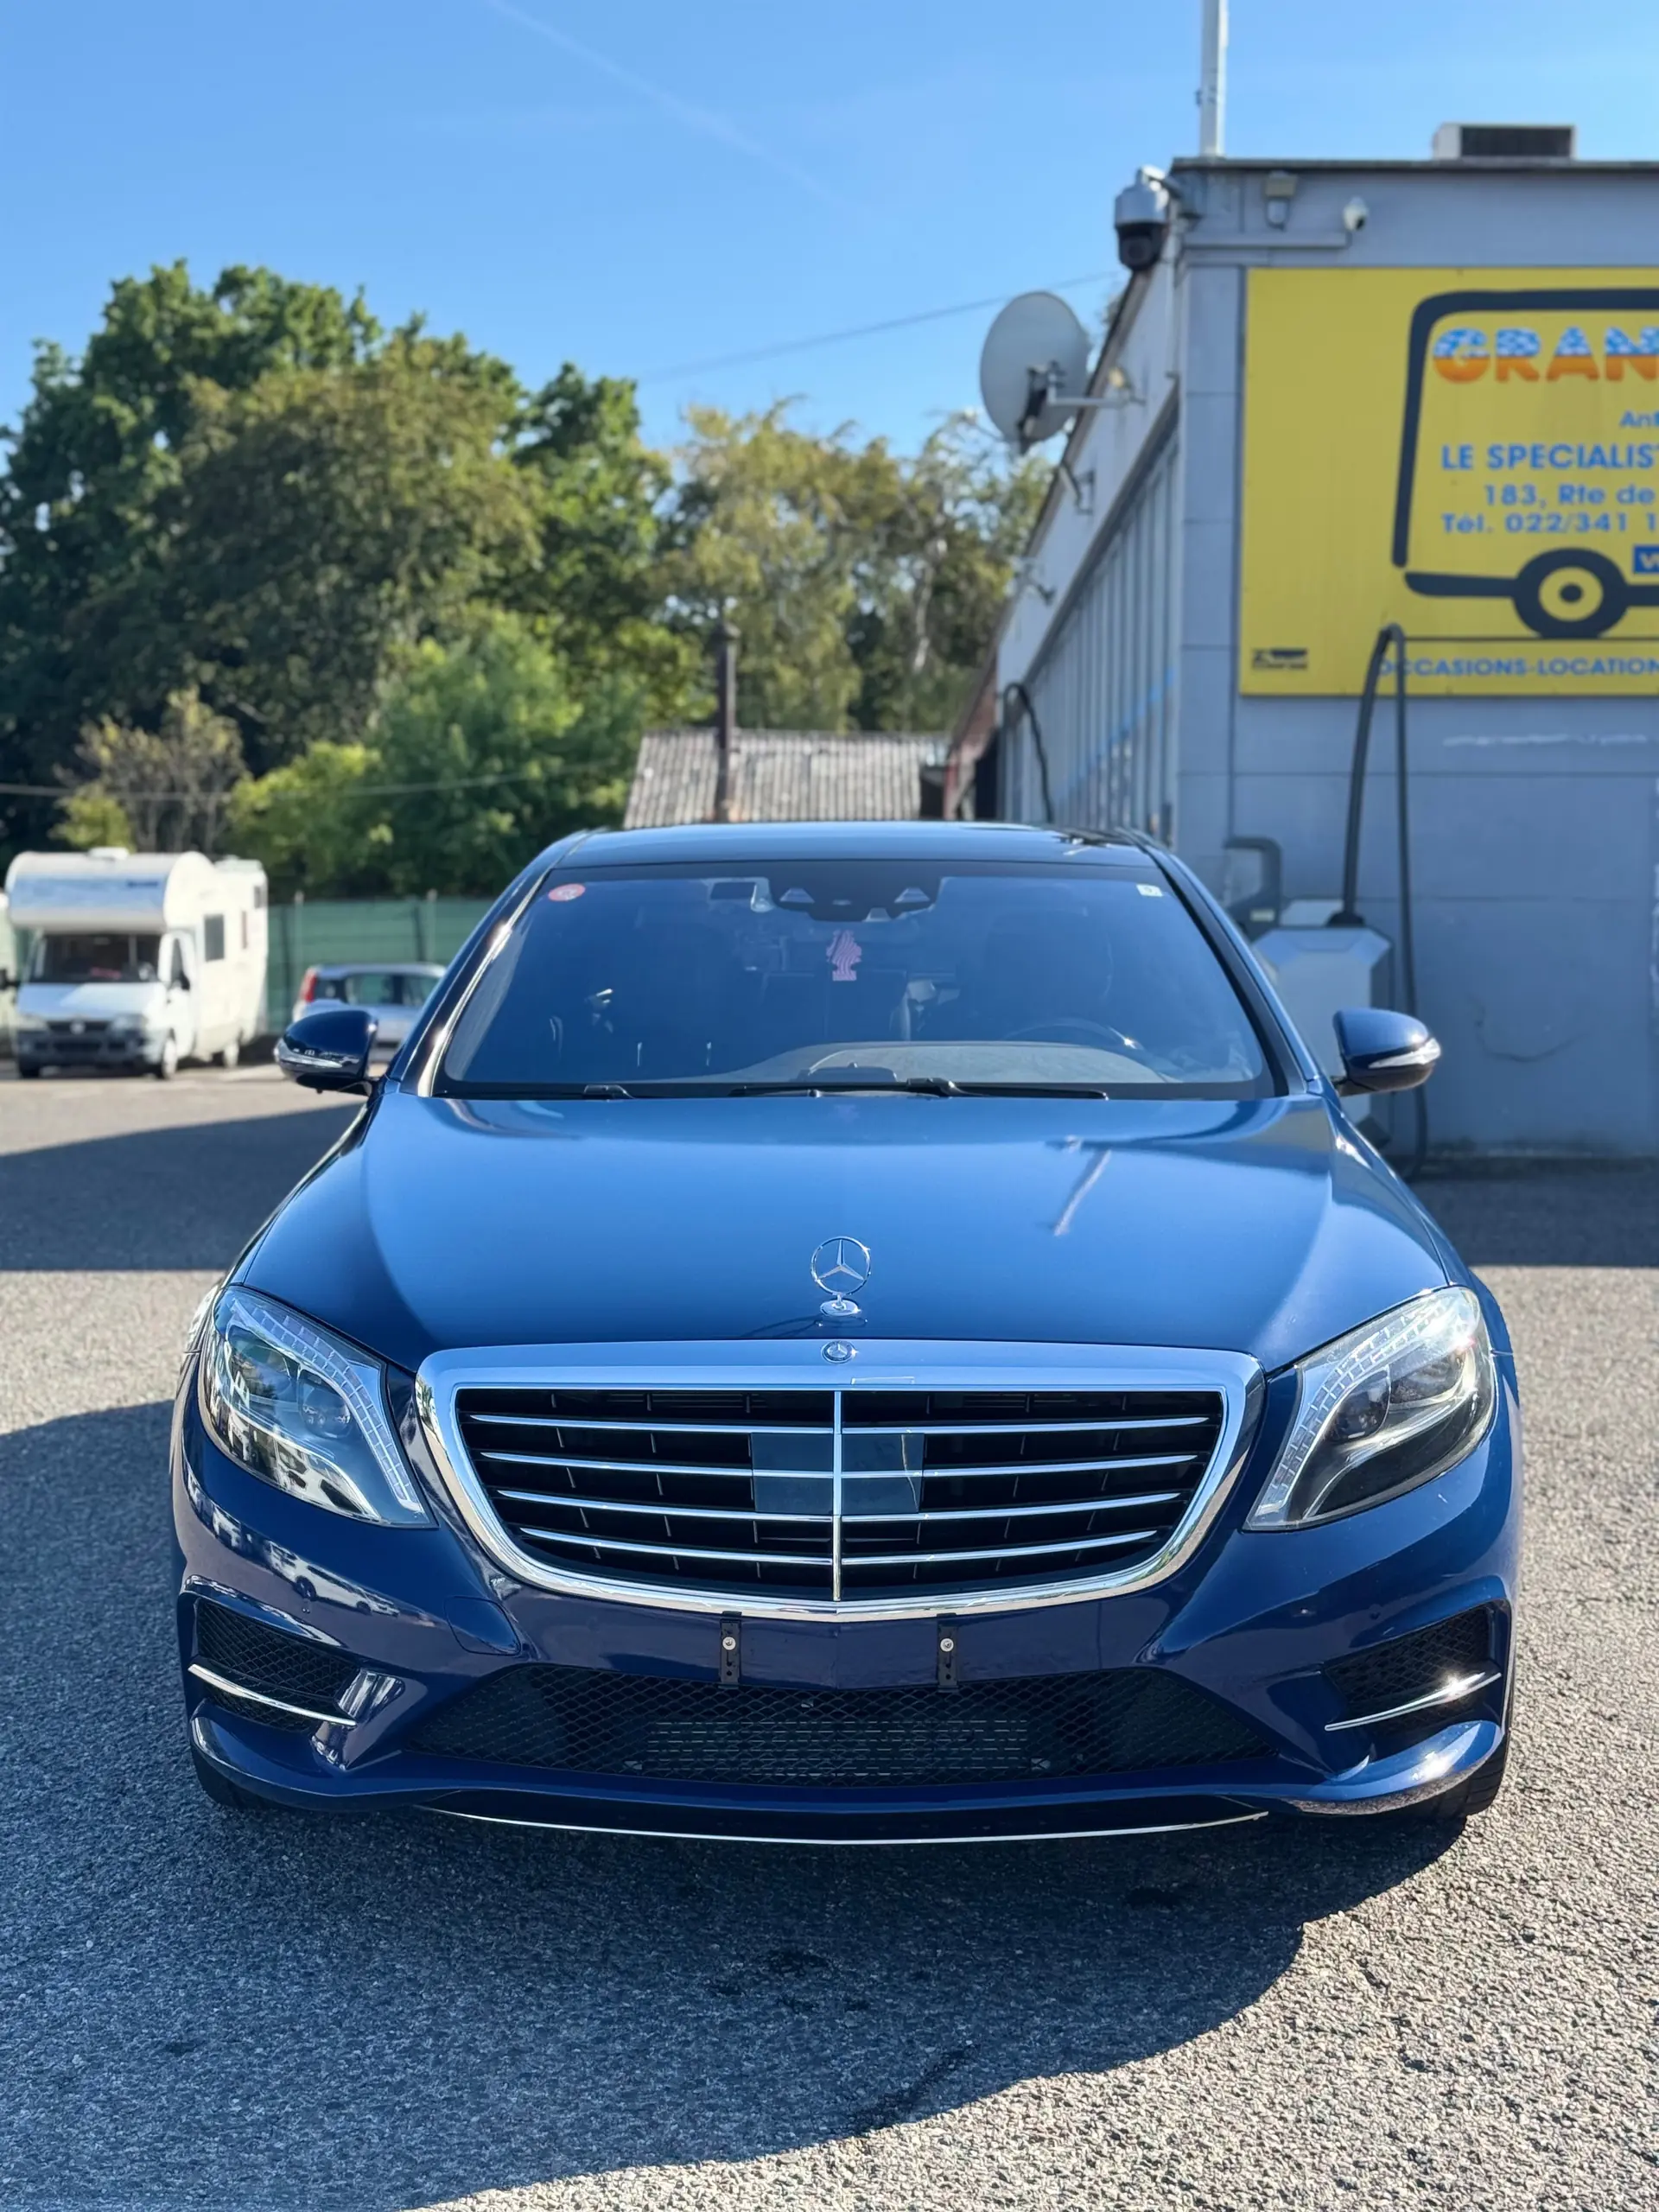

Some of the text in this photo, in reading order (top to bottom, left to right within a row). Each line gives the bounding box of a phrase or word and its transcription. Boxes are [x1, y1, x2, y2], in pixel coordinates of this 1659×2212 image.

[1433, 327, 1659, 384] GRAN
[1441, 443, 1659, 470] LE SPECIALIS
[1484, 482, 1656, 510] 183, Rte de
[1504, 512, 1628, 533] 022/341
